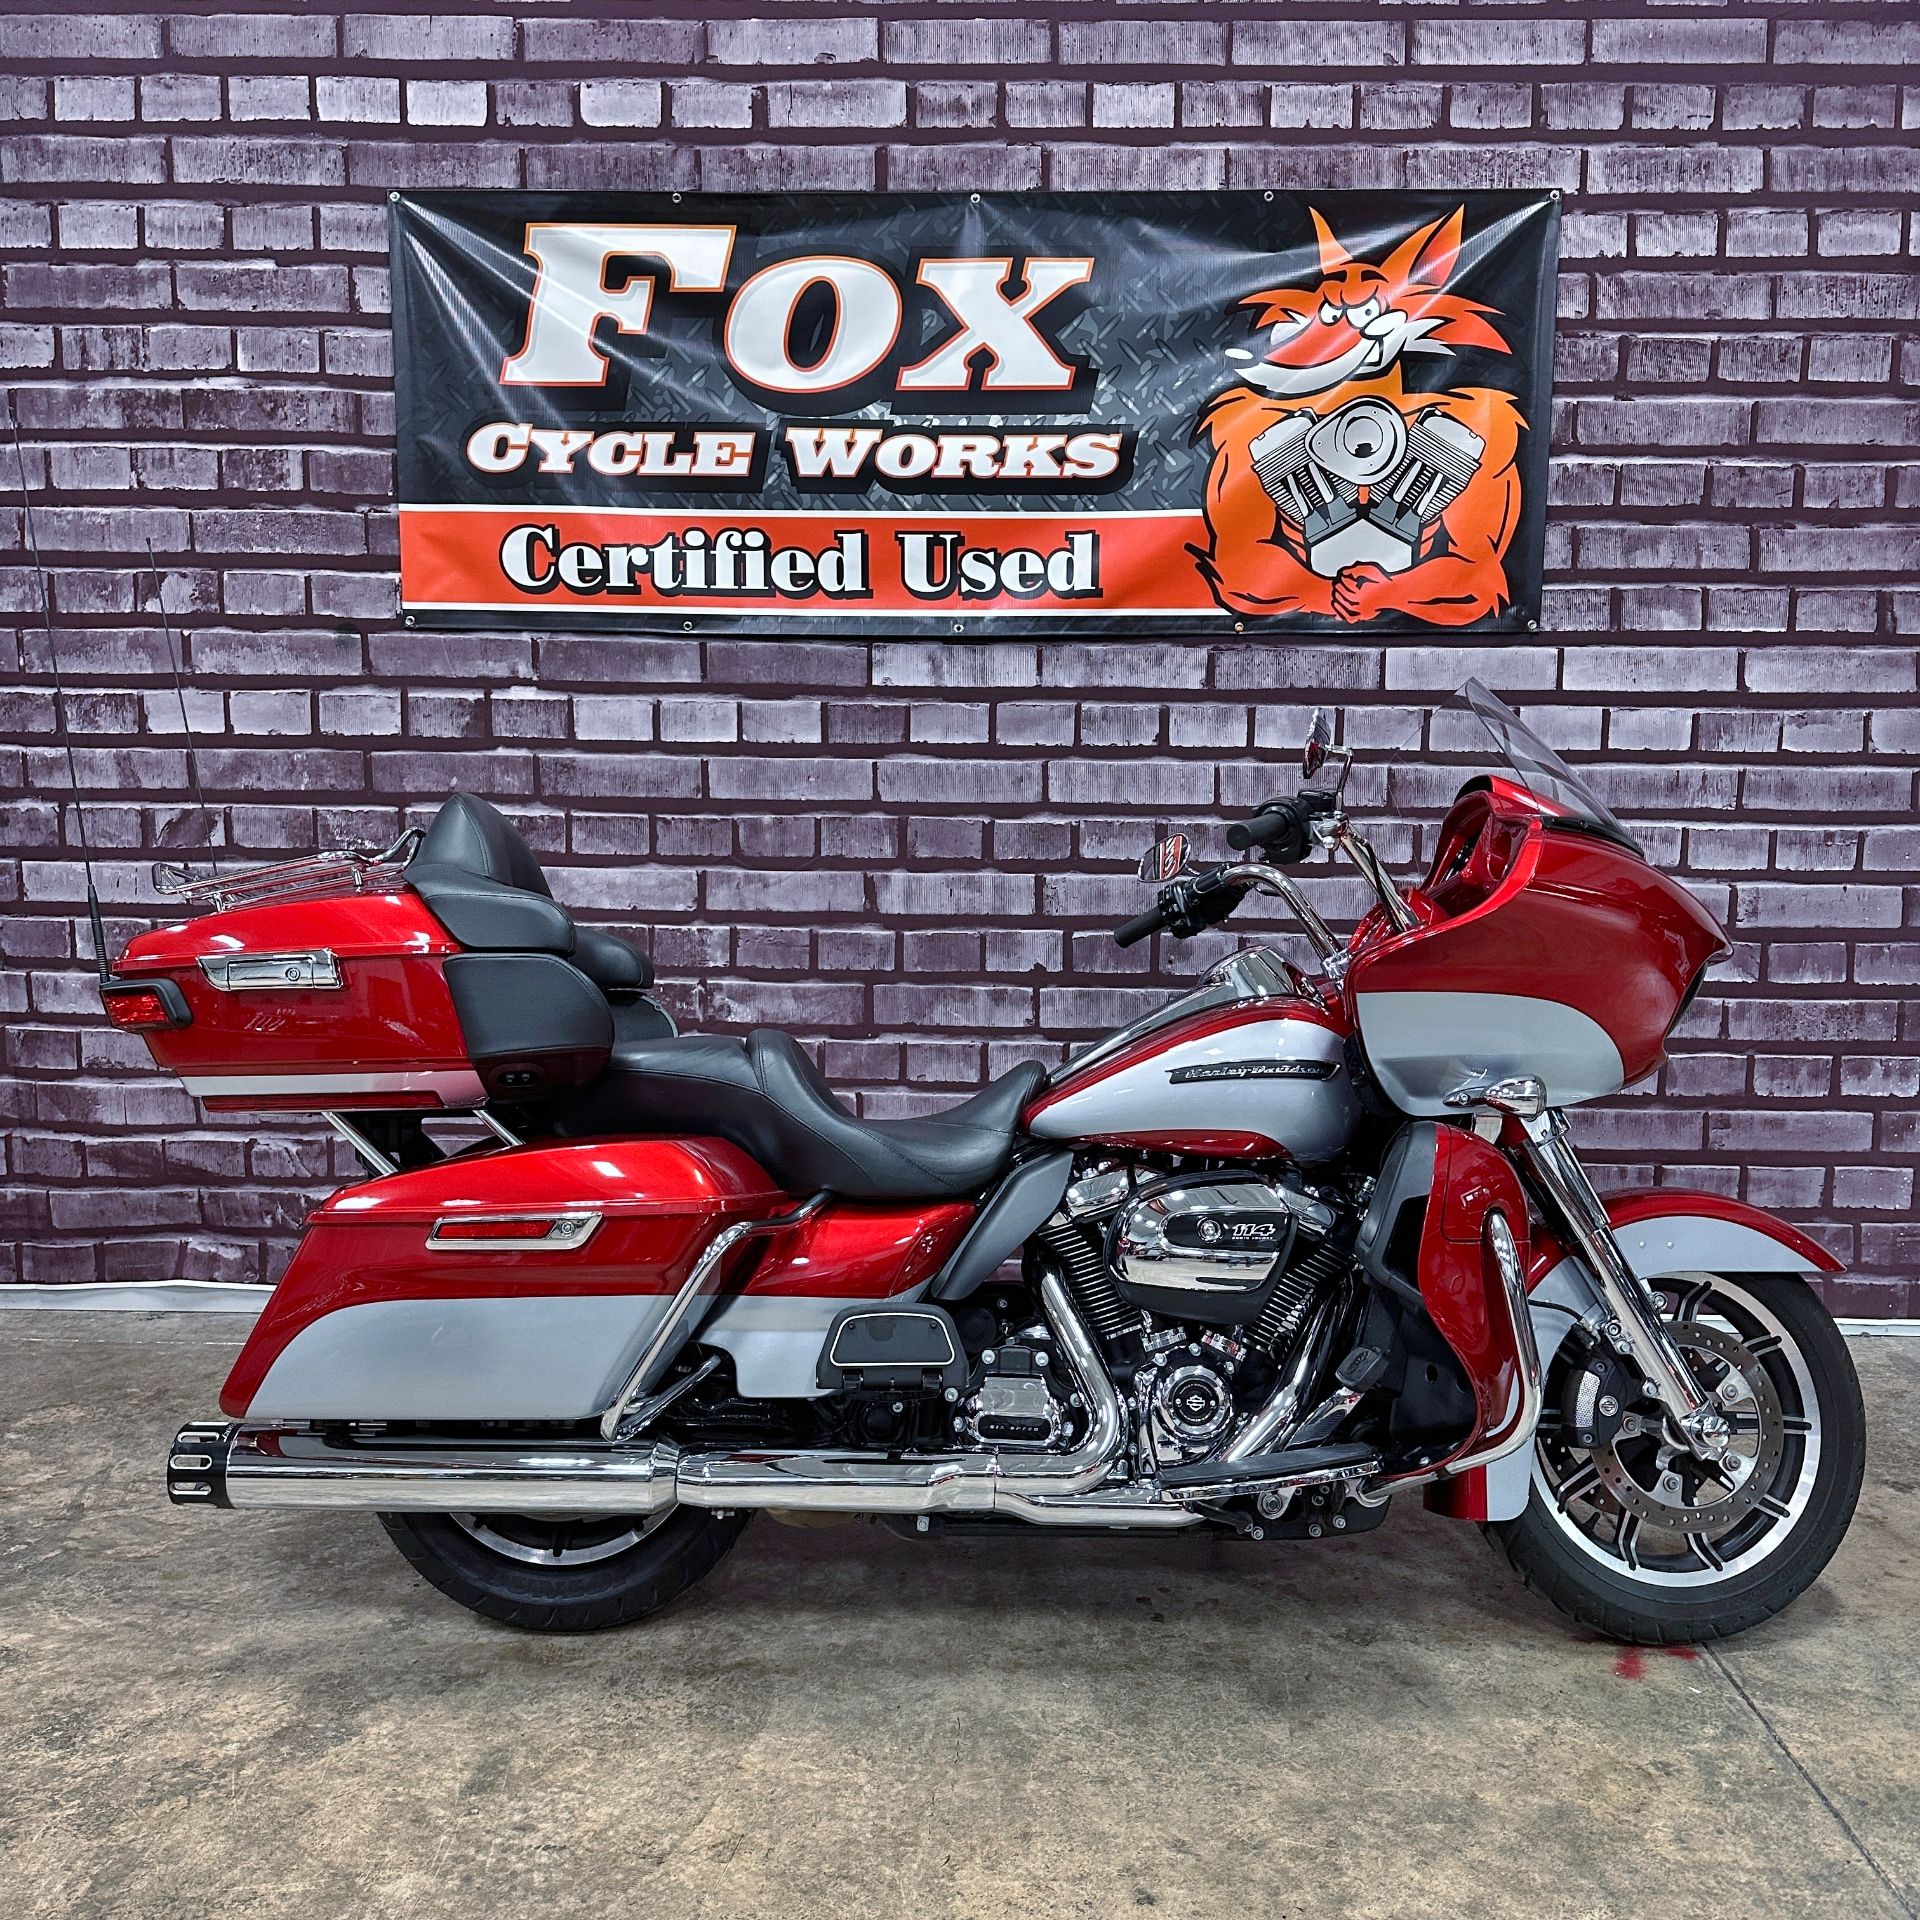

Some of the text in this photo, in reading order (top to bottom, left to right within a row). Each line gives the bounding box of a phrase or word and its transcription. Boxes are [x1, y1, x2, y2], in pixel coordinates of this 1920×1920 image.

[465, 422, 1123, 479] CYCLE WORKS
[500, 525, 1100, 596] Certified Used
[1232, 1223, 1276, 1237] 114
